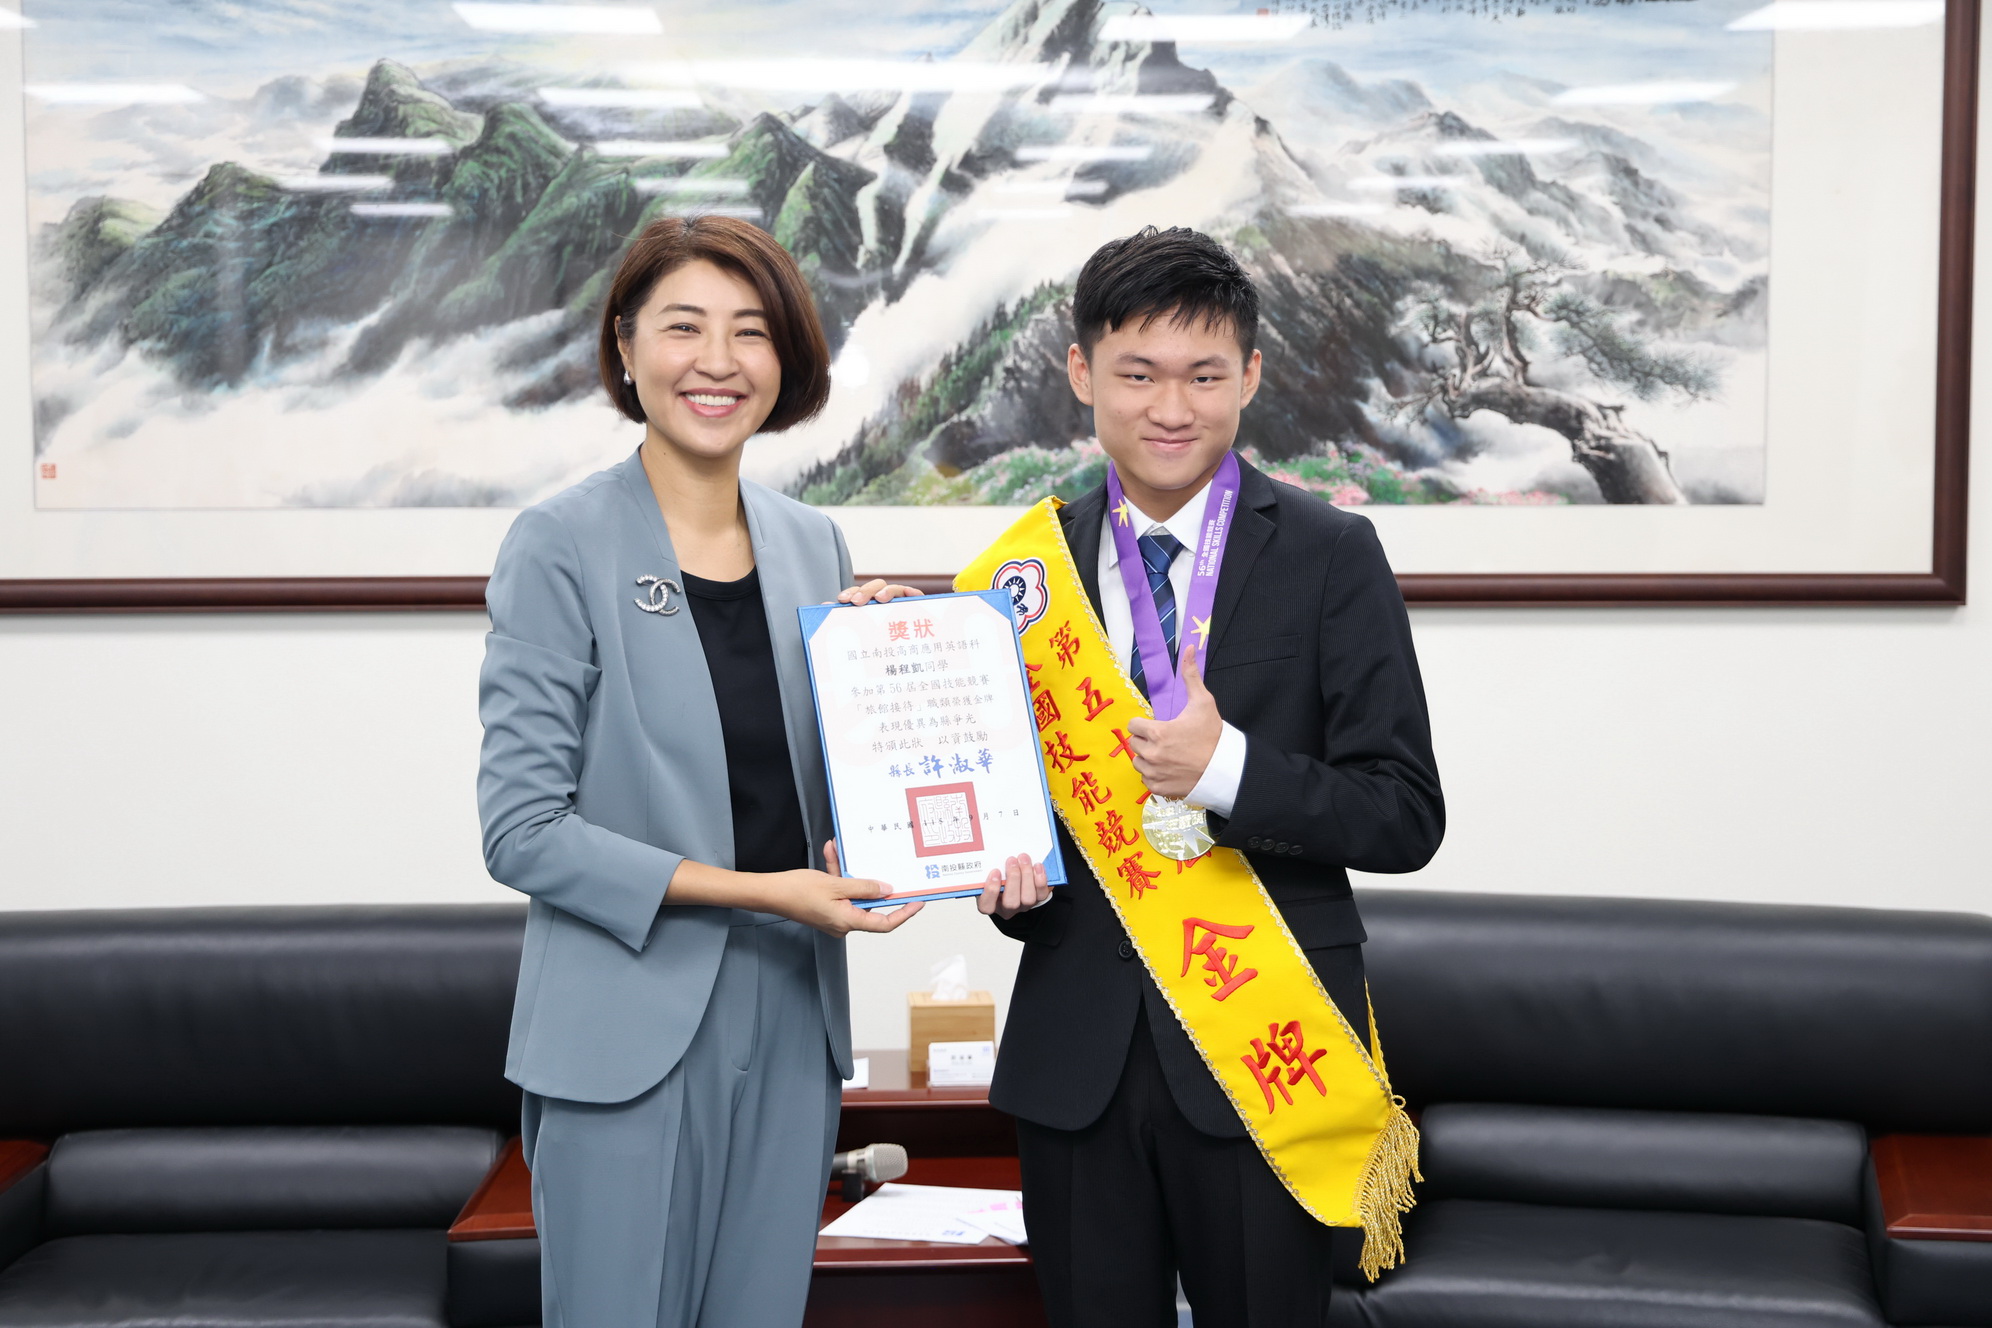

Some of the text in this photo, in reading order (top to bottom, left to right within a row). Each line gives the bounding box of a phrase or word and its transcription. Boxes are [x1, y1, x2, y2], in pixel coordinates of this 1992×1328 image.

[1205, 489, 1234, 577] NATIONAL SKILLS COMPETITION
[1197, 559, 1207, 577] 56th
[888, 618, 935, 641] 獎狀
[847, 638, 980, 661] 國立南投高商應用英語科
[885, 659, 949, 676] 楊程凱同學
[1180, 917, 1328, 1115] 金牌
